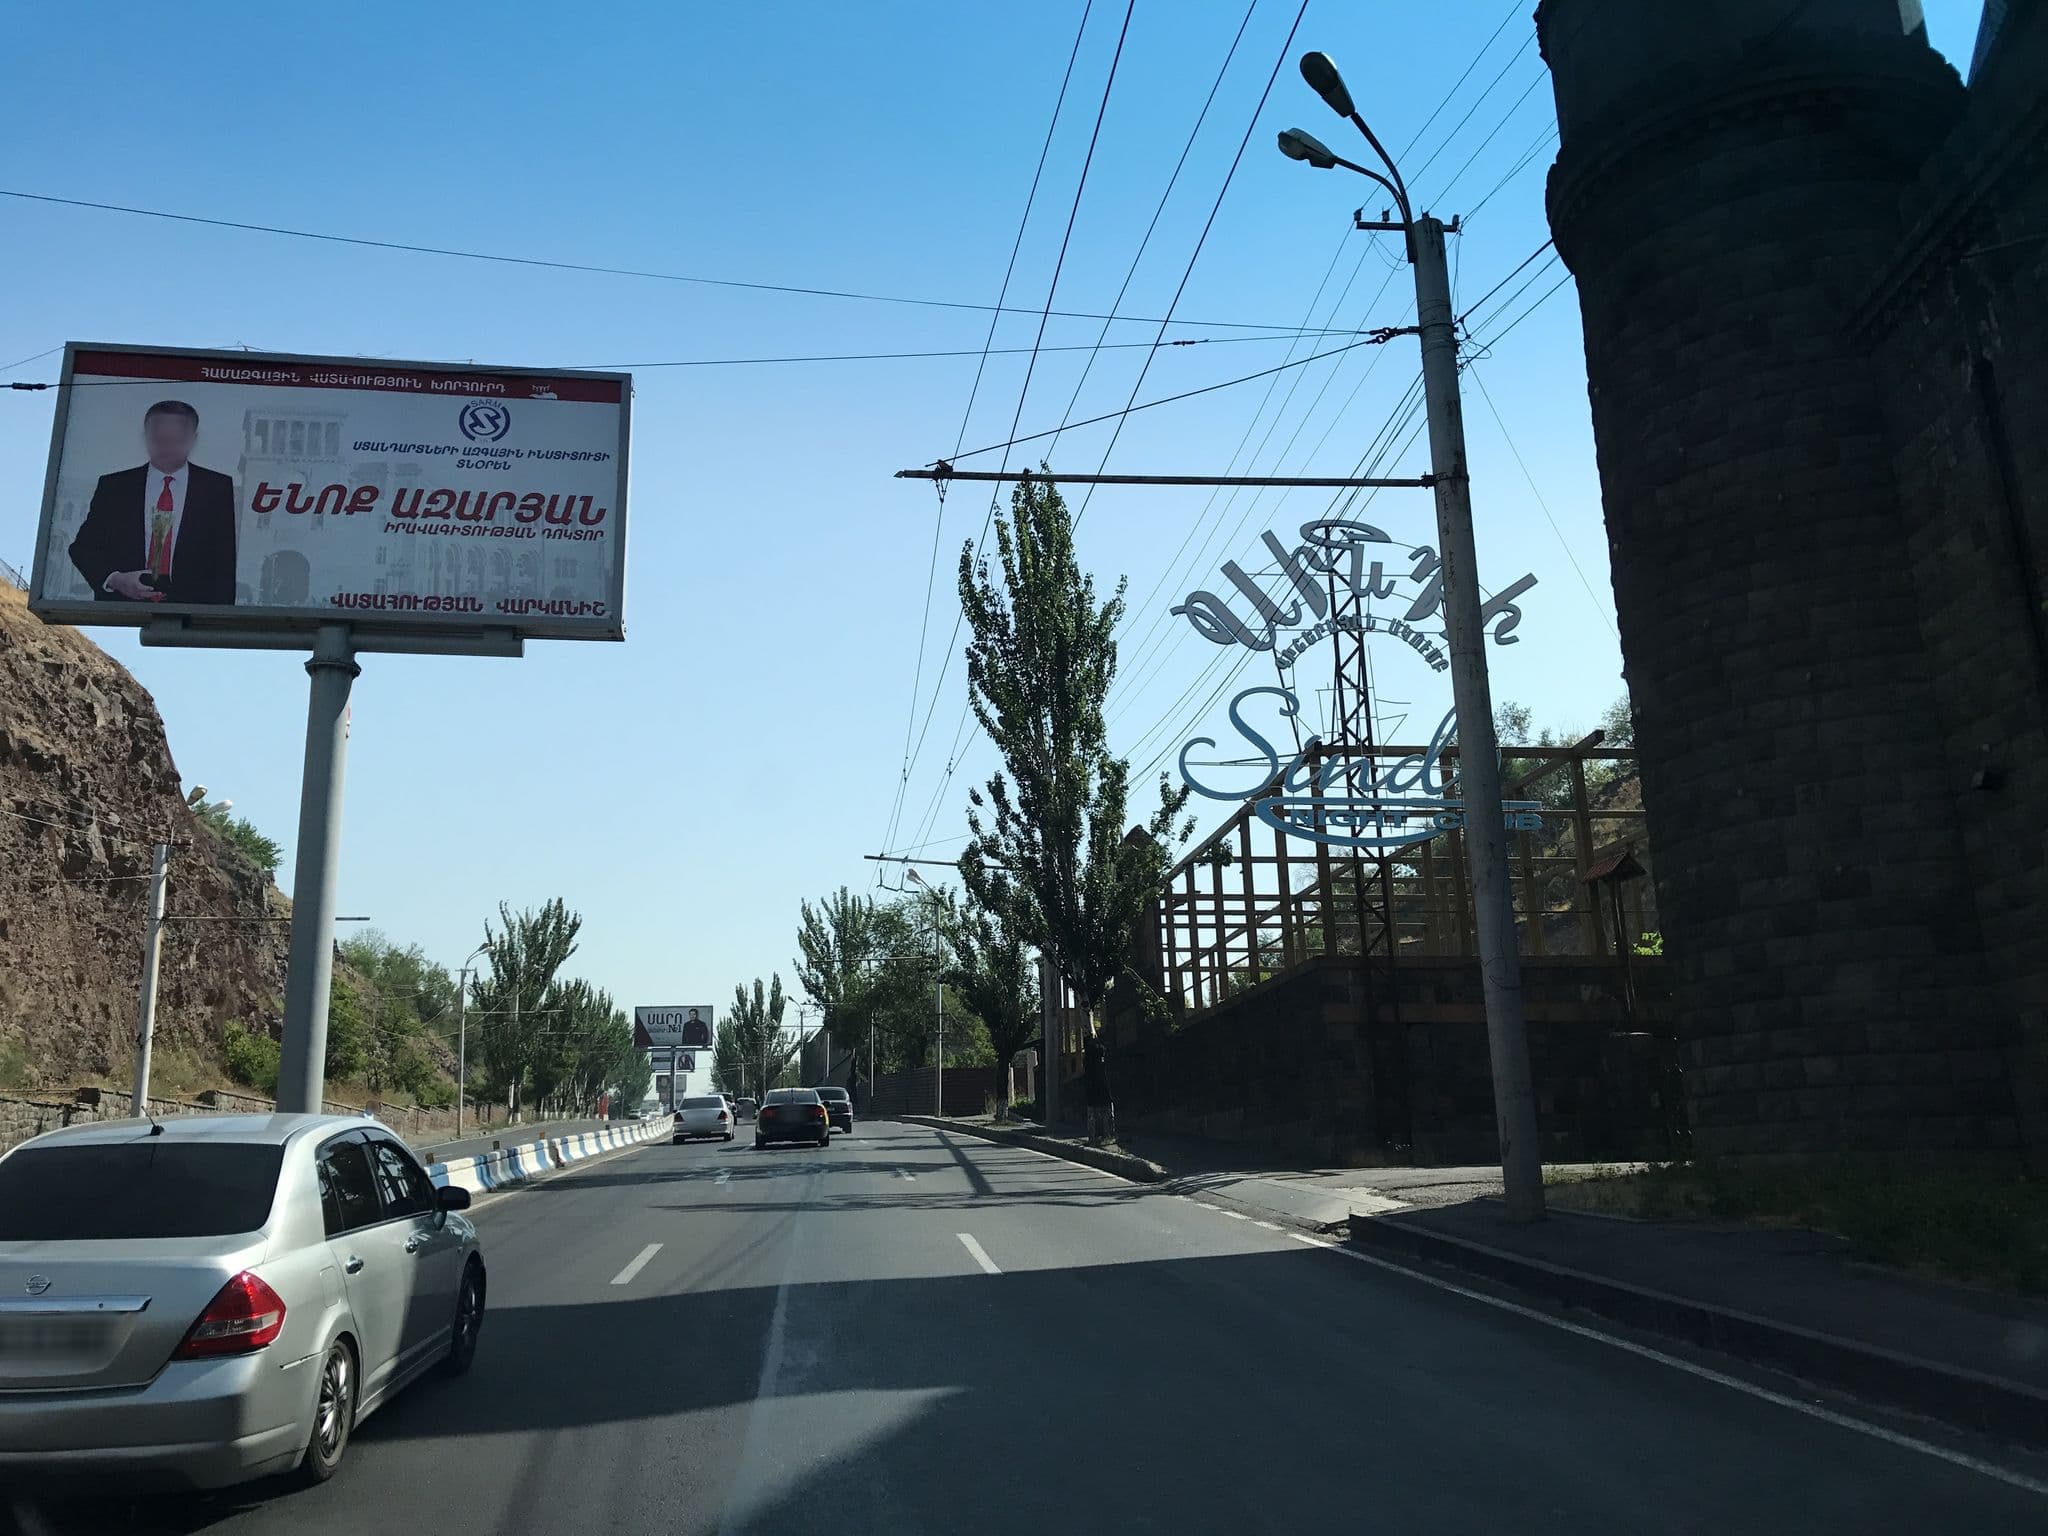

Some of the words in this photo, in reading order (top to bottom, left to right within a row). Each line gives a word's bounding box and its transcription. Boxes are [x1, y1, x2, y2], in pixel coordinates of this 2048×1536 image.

[201, 367, 300, 382] ՀԱՄԱԶԳԱՅԻՆ
[309, 373, 422, 389] ՎՍՏԱՀՈՒԹՅՈՒՆ
[431, 379, 506, 393] ԽՈՐՀՈՒՐԴ
[353, 440, 459, 455] ՍՏԱՆԴԱՐՏՆԵՐԻ
[462, 446, 524, 458] ԱԶԳԱՅԻՆ
[527, 449, 611, 462] ԻՆՍՏԻՏՈՒՏԻ
[456, 459, 512, 471] ՏՆՕՐԵՆ
[251, 482, 380, 515] ԵՆՈՔ
[391, 487, 606, 526] ԱԶԱՐՅԱՆ
[384, 521, 537, 539] ԻՐԱՎԱԳԻՏՈՒԹՅԱՆ
[541, 528, 605, 542] ԴՈԿՏՈՐ
[330, 592, 484, 613] ՎՍՏԱՀՈՒԹՅԱՆ
[496, 599, 606, 617] ՎԱՐԿԱՆԻՇ
[1179, 686, 1502, 801] Sind
[1289, 808, 1409, 828] NIGHT
[647, 1013, 682, 1024] ՍԱՐՈ
